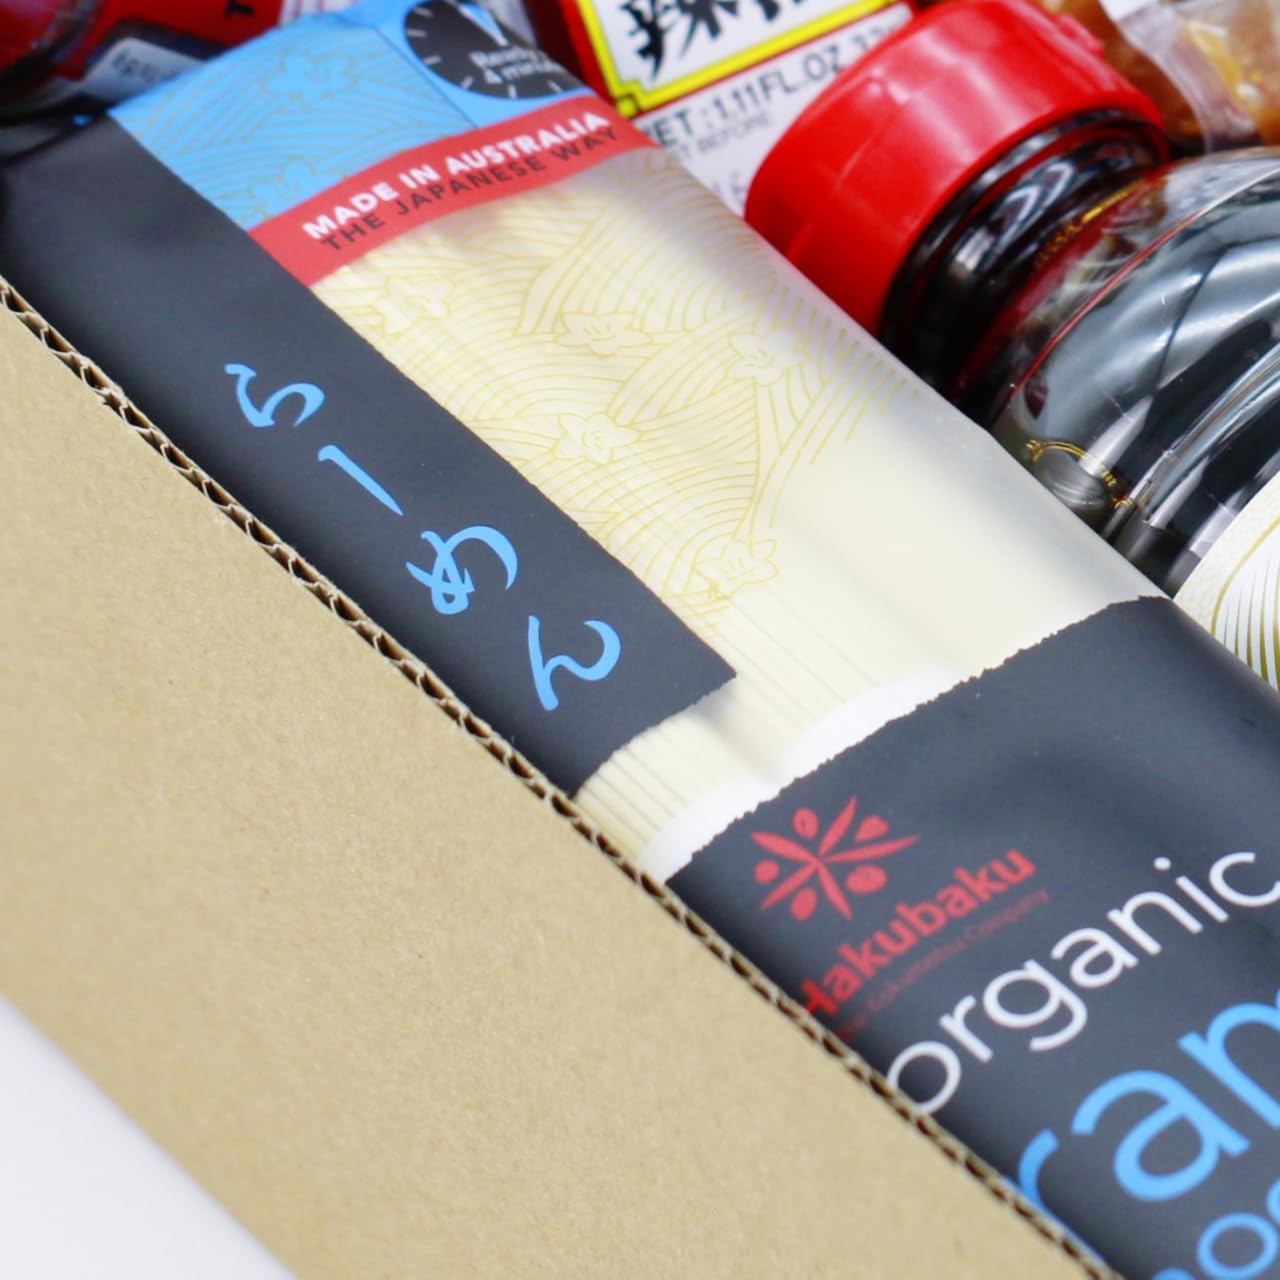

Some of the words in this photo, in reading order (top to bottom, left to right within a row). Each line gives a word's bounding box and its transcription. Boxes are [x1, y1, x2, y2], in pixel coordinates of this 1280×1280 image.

[303, 181, 400, 240] MADE
[400, 164, 441, 190] IN
[445, 112, 611, 175] AUSTRALIA
[321, 213, 386, 252] THE
[395, 154, 546, 216] JAPANESE
[551, 127, 618, 162] WAY
[225, 362, 622, 711] らーめん
